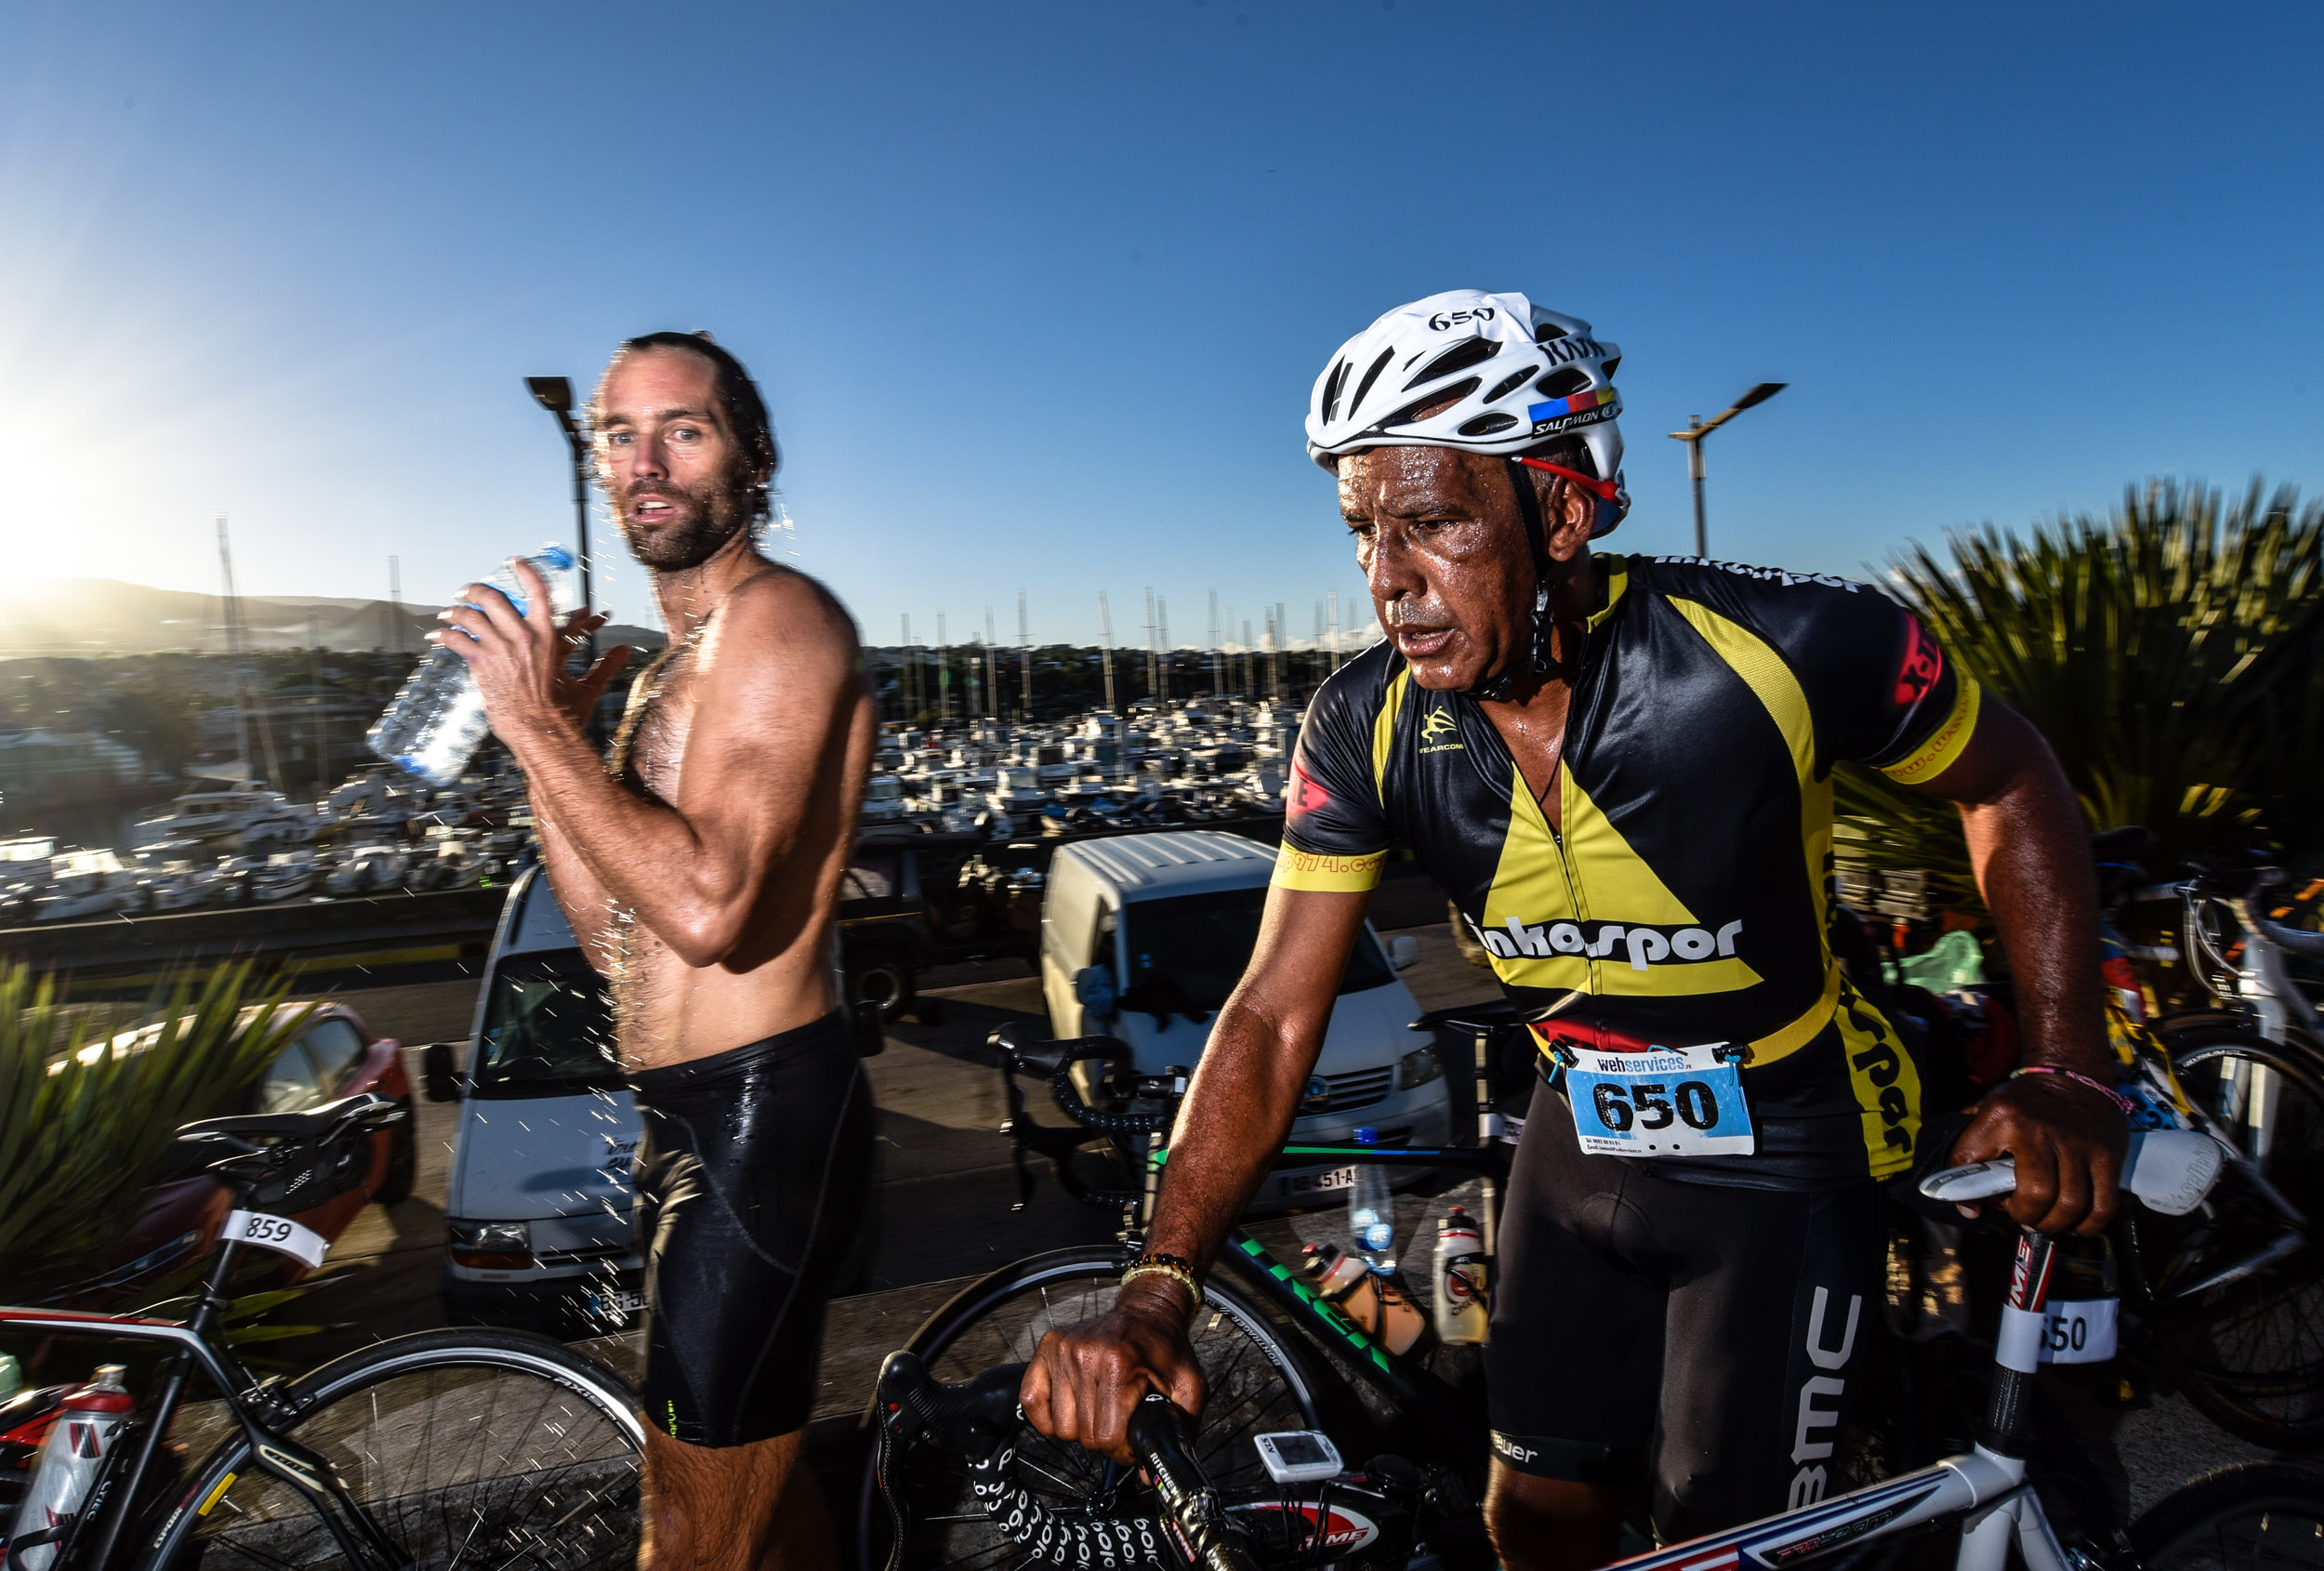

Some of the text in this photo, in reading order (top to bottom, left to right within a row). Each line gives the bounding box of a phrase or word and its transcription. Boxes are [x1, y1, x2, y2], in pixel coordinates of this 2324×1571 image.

[1428, 307, 1496, 331] 650
[1535, 410, 1599, 436] SALOMON
[1592, 1080, 1720, 1132] 650
[244, 1217, 293, 1242] 859
[1230, 1314, 1282, 1367] BONTRAGER
[1149, 1452, 1179, 1497] RITCHEY
